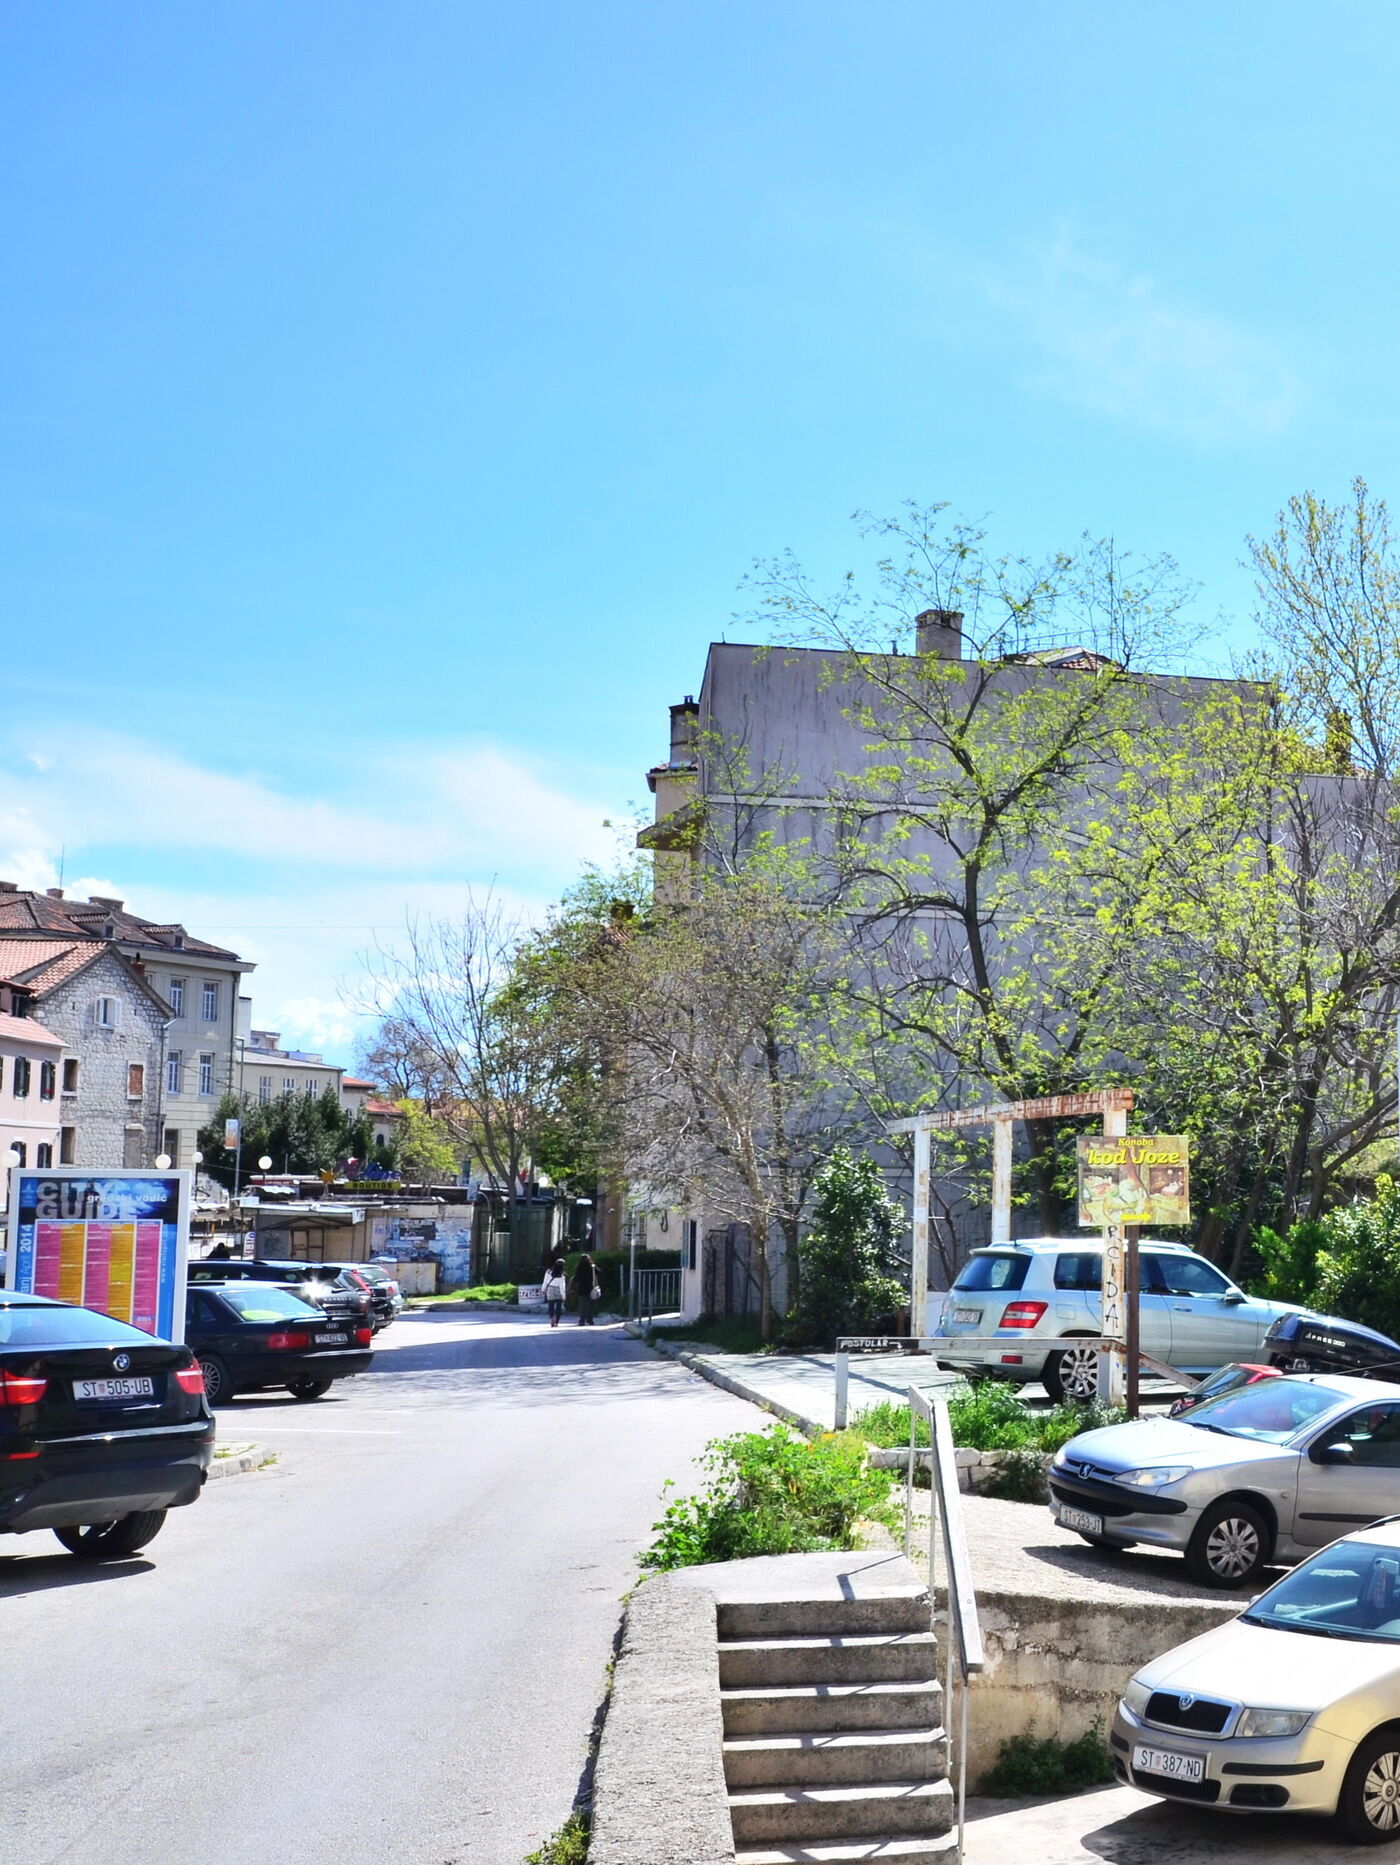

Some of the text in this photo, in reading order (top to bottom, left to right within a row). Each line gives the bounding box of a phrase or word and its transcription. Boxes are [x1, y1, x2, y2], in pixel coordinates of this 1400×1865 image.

[1118, 1138, 1154, 1147] Konoba
[1087, 1149, 1181, 1165] kod Joze
[37, 1182, 114, 1200] CITY
[36, 1200, 138, 1219] GUIDE
[20, 1224, 32, 1252] 2014
[840, 1339, 888, 1349] POSTOLAR
[82, 1379, 151, 1396] ST 505-UB
[1140, 1749, 1201, 1777] ST 387-ND
